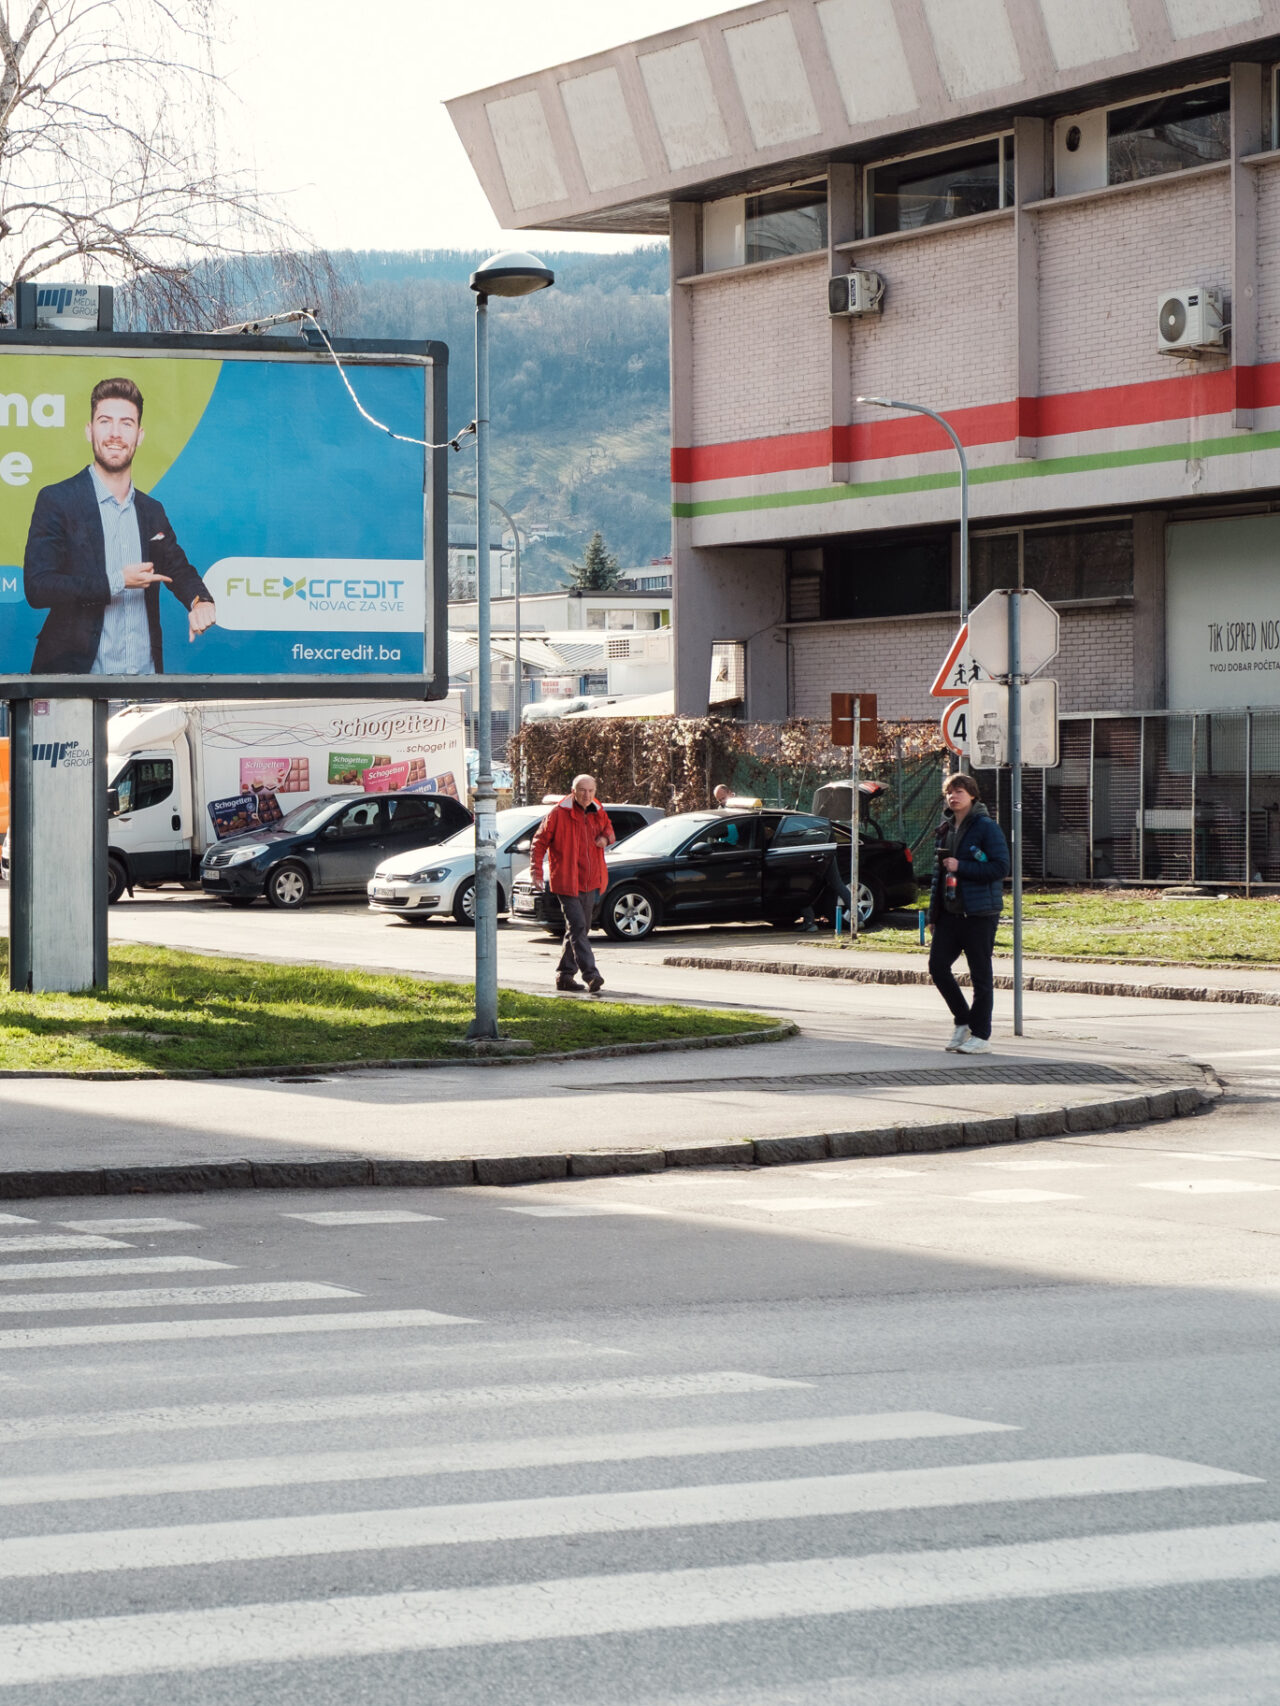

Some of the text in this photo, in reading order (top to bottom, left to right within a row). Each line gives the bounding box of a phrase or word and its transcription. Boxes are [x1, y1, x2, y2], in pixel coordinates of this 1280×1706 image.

[75, 289, 88, 297] MP
[73, 298, 96, 307] MEDIA
[72, 307, 98, 316] GROUP
[309, 601, 404, 612] NOVAC ZA SVE
[292, 644, 401, 660] flexcredit.ba
[1210, 663, 1227, 672] TVOJ
[1228, 662, 1252, 672] DOBAR
[327, 715, 446, 741] Schogetten
[953, 713, 967, 741] 4
[65, 741, 79, 750] MP
[65, 749, 90, 759] MEDIA
[333, 755, 369, 765] Schogetten
[368, 766, 405, 780] Schogetten
[215, 796, 252, 810] Schogetten
